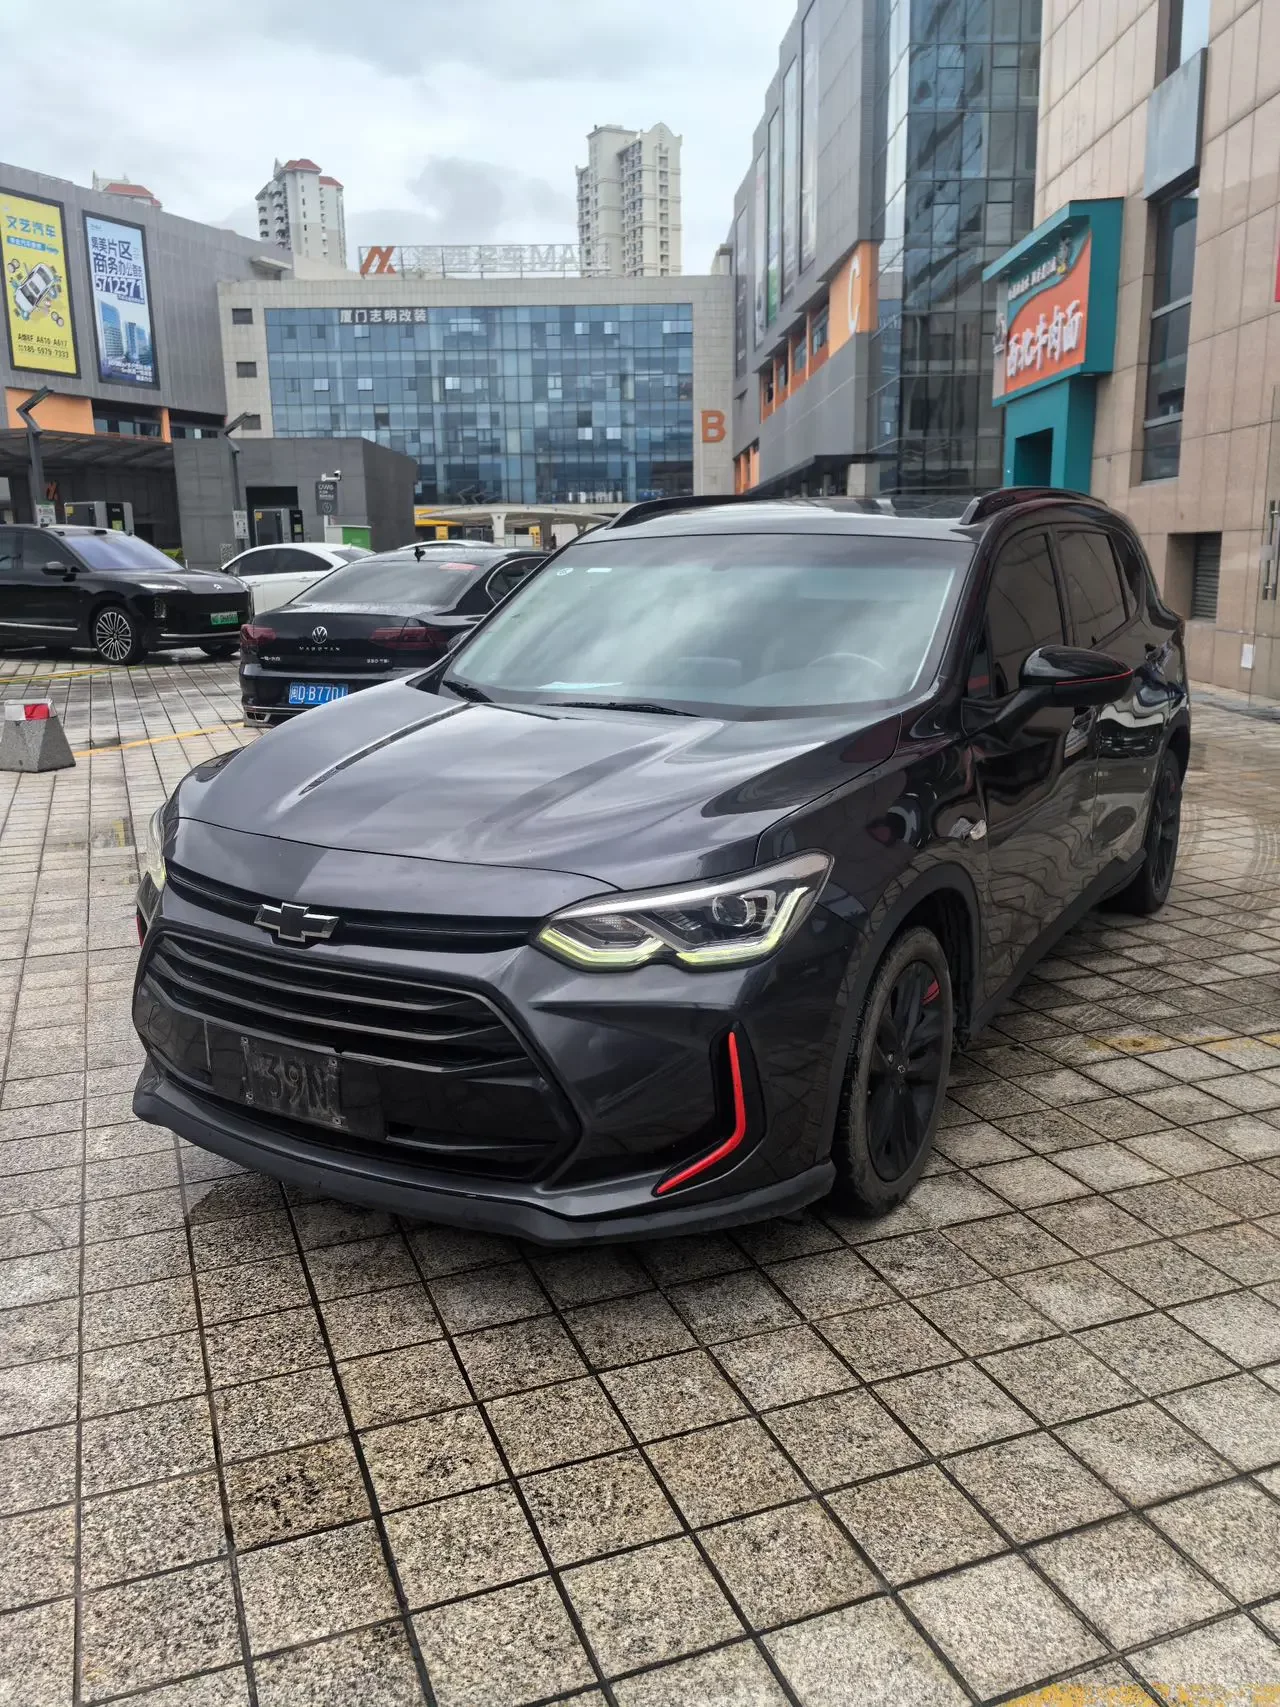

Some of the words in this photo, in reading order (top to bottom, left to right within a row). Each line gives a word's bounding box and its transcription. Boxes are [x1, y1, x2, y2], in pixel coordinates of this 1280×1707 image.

[6, 215, 56, 238] 文艺汽车
[847, 255, 861, 335] C
[340, 308, 427, 324] 厦门志明改装
[701, 410, 726, 443] B
